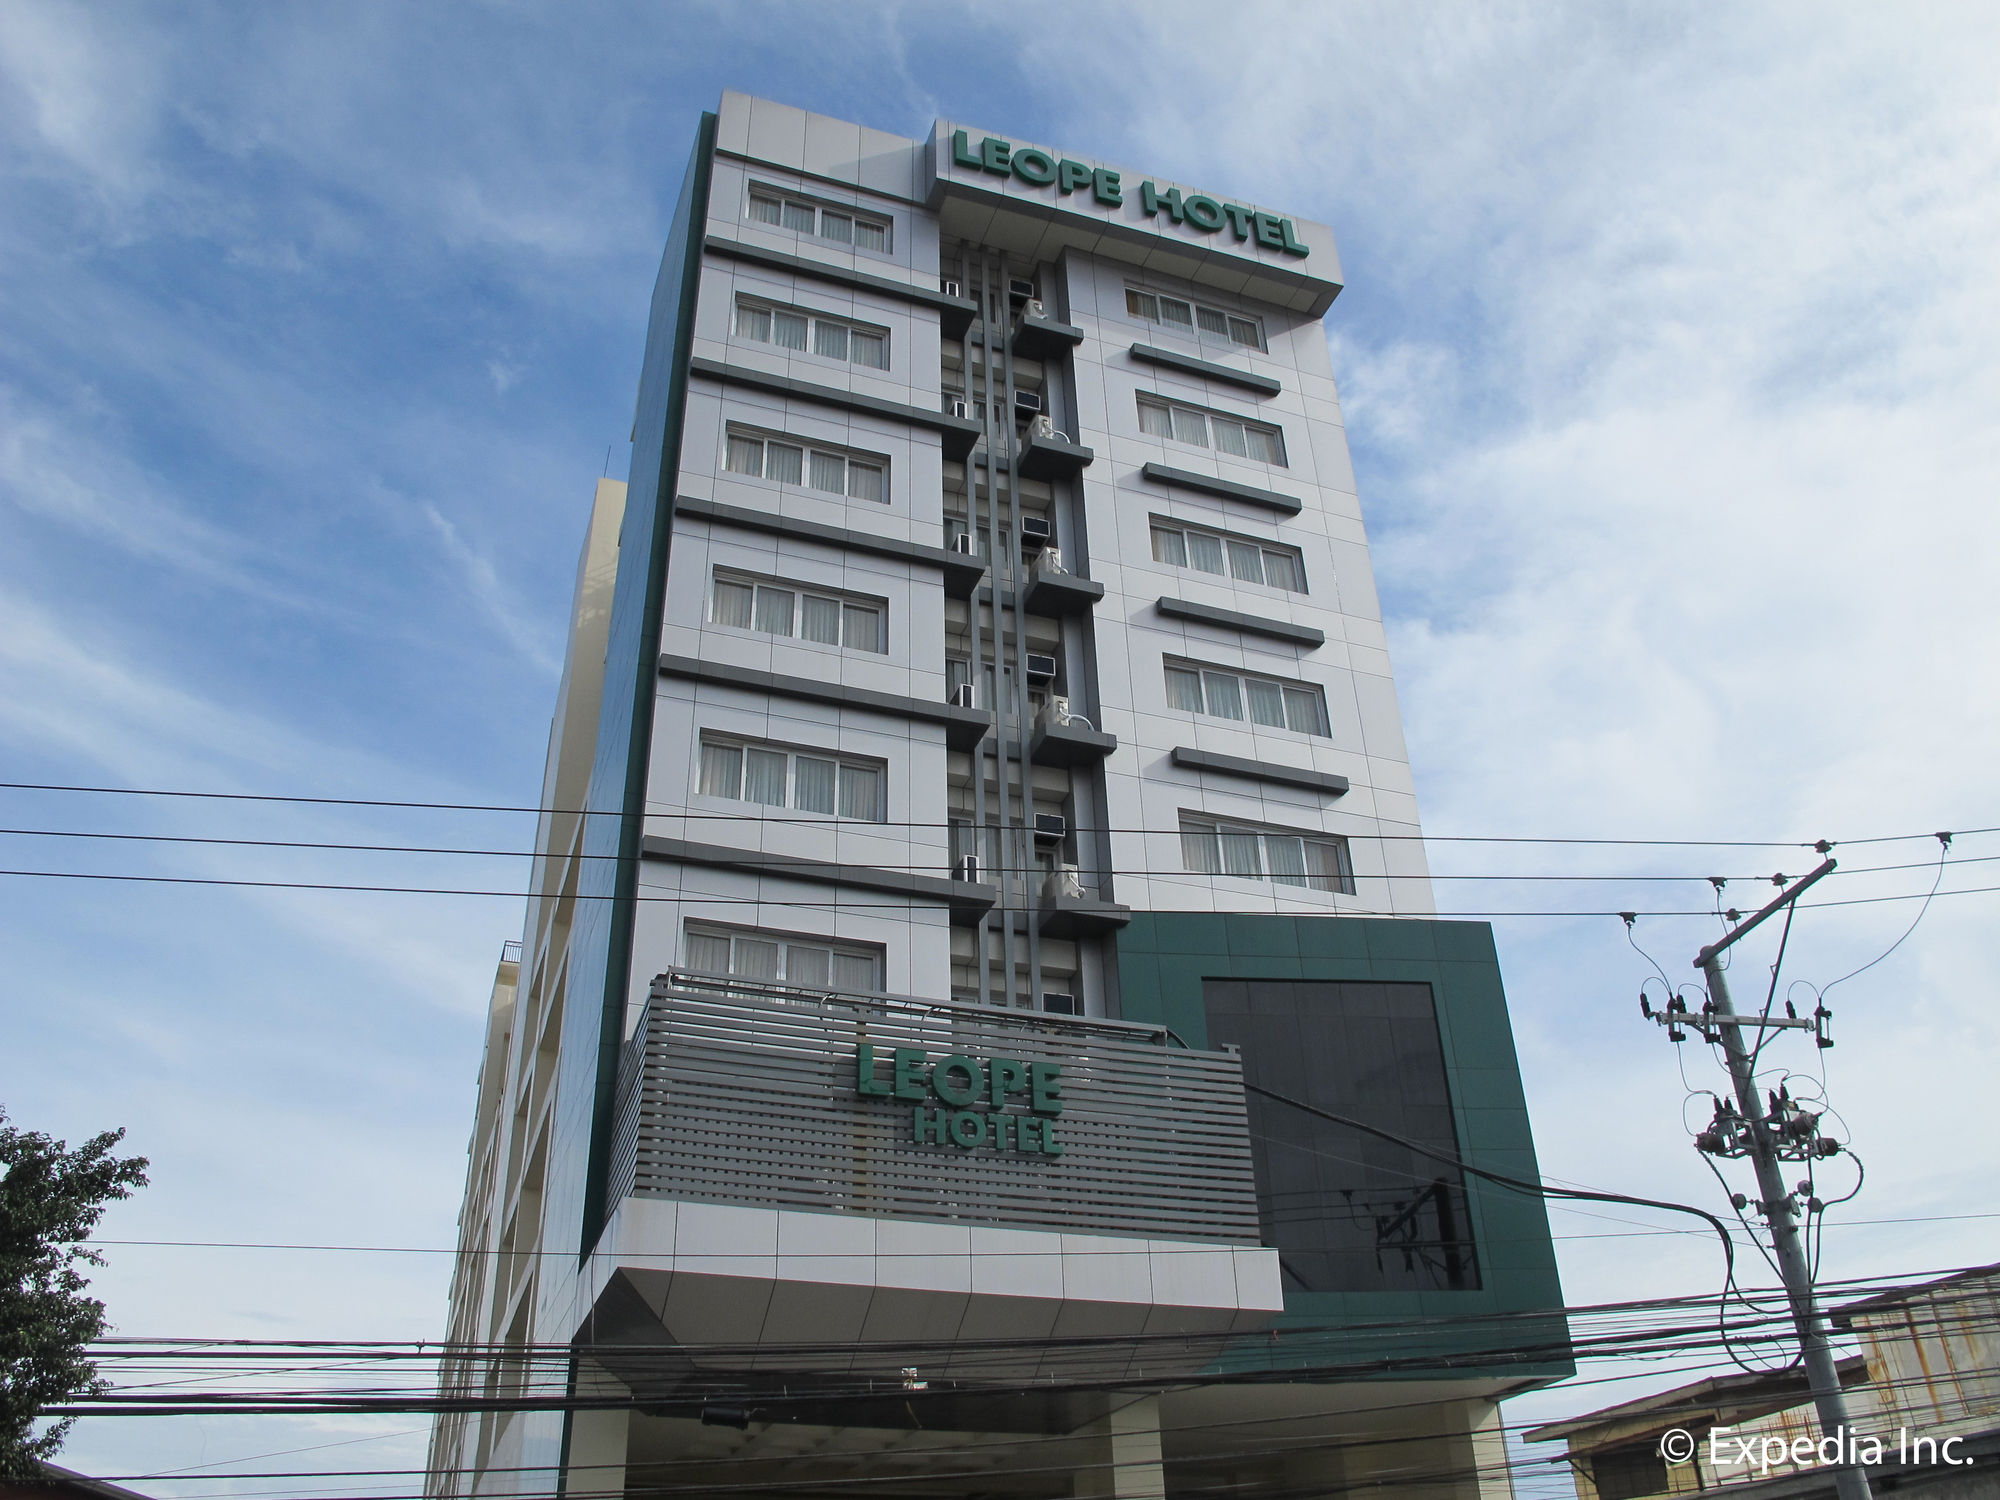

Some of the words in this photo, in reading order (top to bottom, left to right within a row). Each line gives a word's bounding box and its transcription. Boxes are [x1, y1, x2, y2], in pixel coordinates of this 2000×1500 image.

[953, 129, 1123, 208] LEOPE
[1140, 180, 1310, 259] HOTEL
[857, 1043, 1063, 1115] LEOPE
[913, 1106, 1064, 1156] HOTEL
